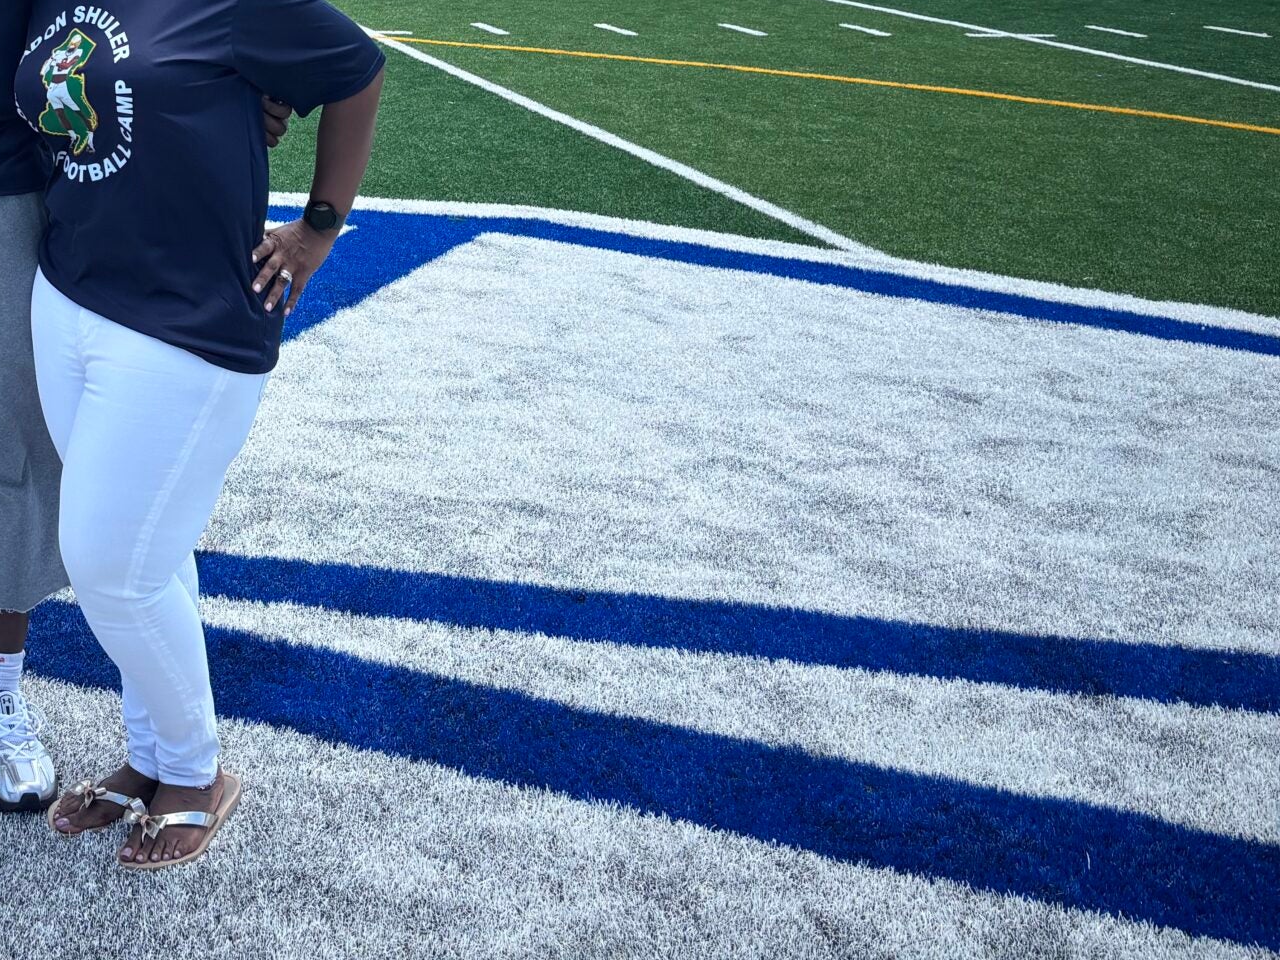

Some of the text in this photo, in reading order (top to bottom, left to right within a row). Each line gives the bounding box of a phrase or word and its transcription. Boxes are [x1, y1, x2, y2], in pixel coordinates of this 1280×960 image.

[72, 5, 130, 64] SHULER
[55, 79, 134, 183] FOOTBALL CAMP
